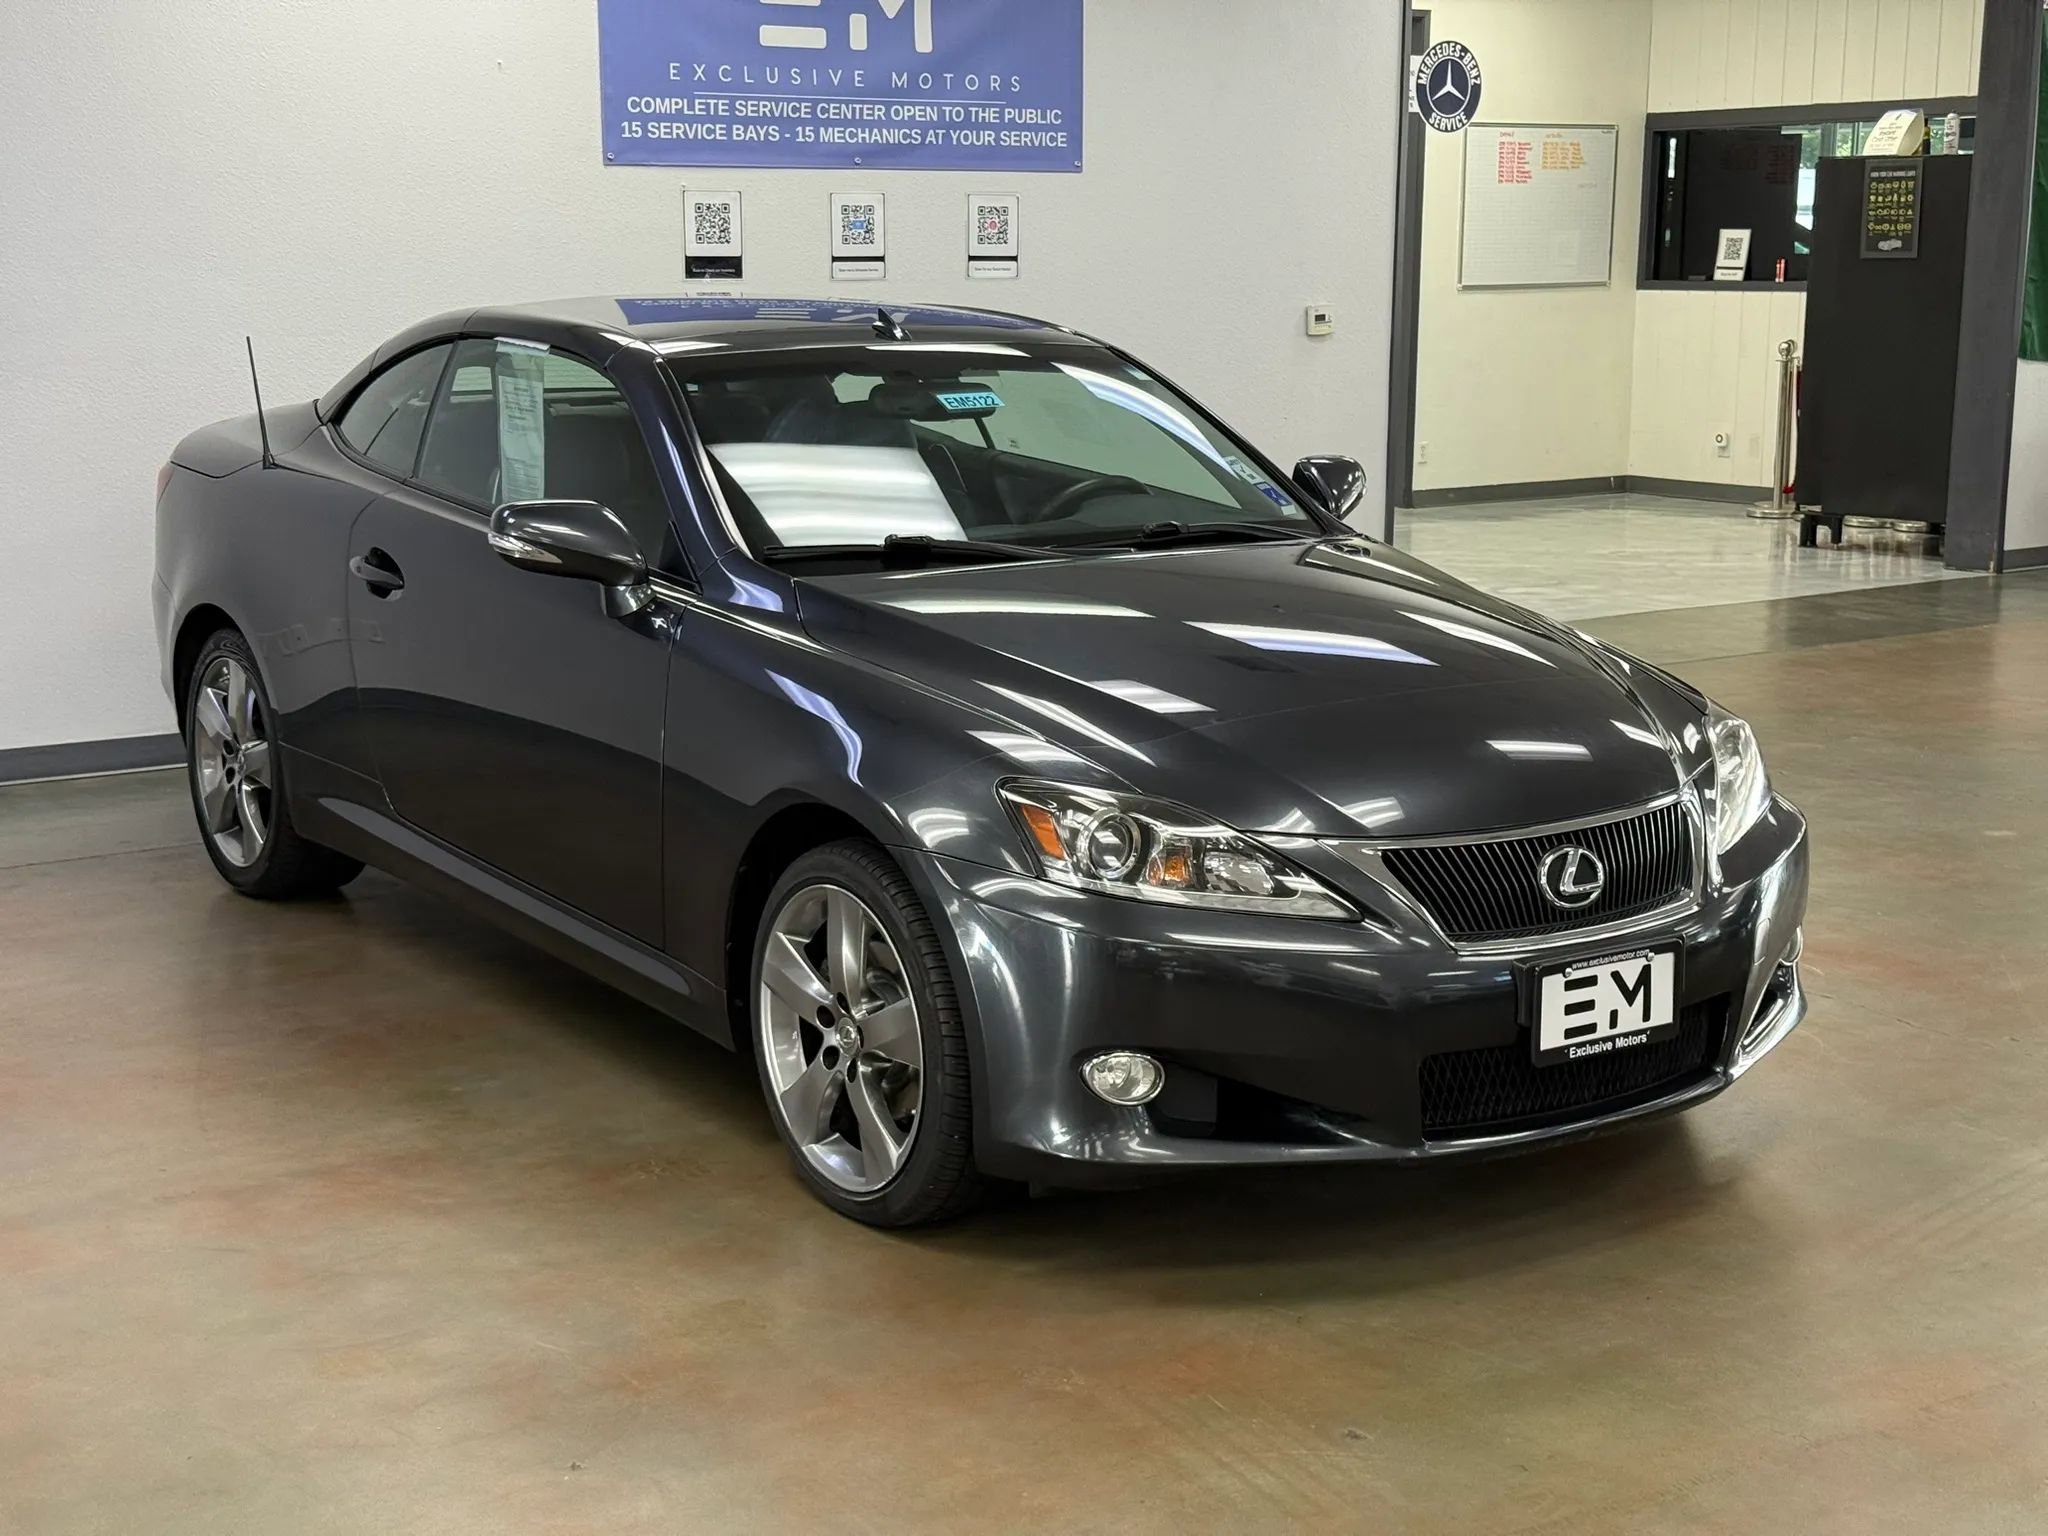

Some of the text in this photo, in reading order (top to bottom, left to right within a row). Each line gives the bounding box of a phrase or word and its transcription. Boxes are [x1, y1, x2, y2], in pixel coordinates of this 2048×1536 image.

[669, 62, 1021, 92] EXCLUSIVE MOTORS
[1417, 43, 1481, 86] MERCEDES-BENZ
[627, 96, 1062, 125] COMPLETE SERVICE CENTER OPEN TO THE PUBLIC
[1428, 111, 1468, 131] SERVICE
[620, 121, 643, 139] 15
[647, 122, 727, 140] SERVICE
[732, 124, 780, 141] BAYS
[795, 126, 815, 142] 15
[819, 127, 921, 145] MECHANICS
[925, 129, 946, 145] AT
[949, 129, 996, 146] YOUR
[1000, 131, 1067, 147] SERVICE
[944, 395, 998, 408] EM5122
[1572, 948, 1650, 970] www.exclusivemotor.com
[1564, 964, 1651, 1039] EM
[1569, 1033, 1648, 1059] Exclusive Motors
